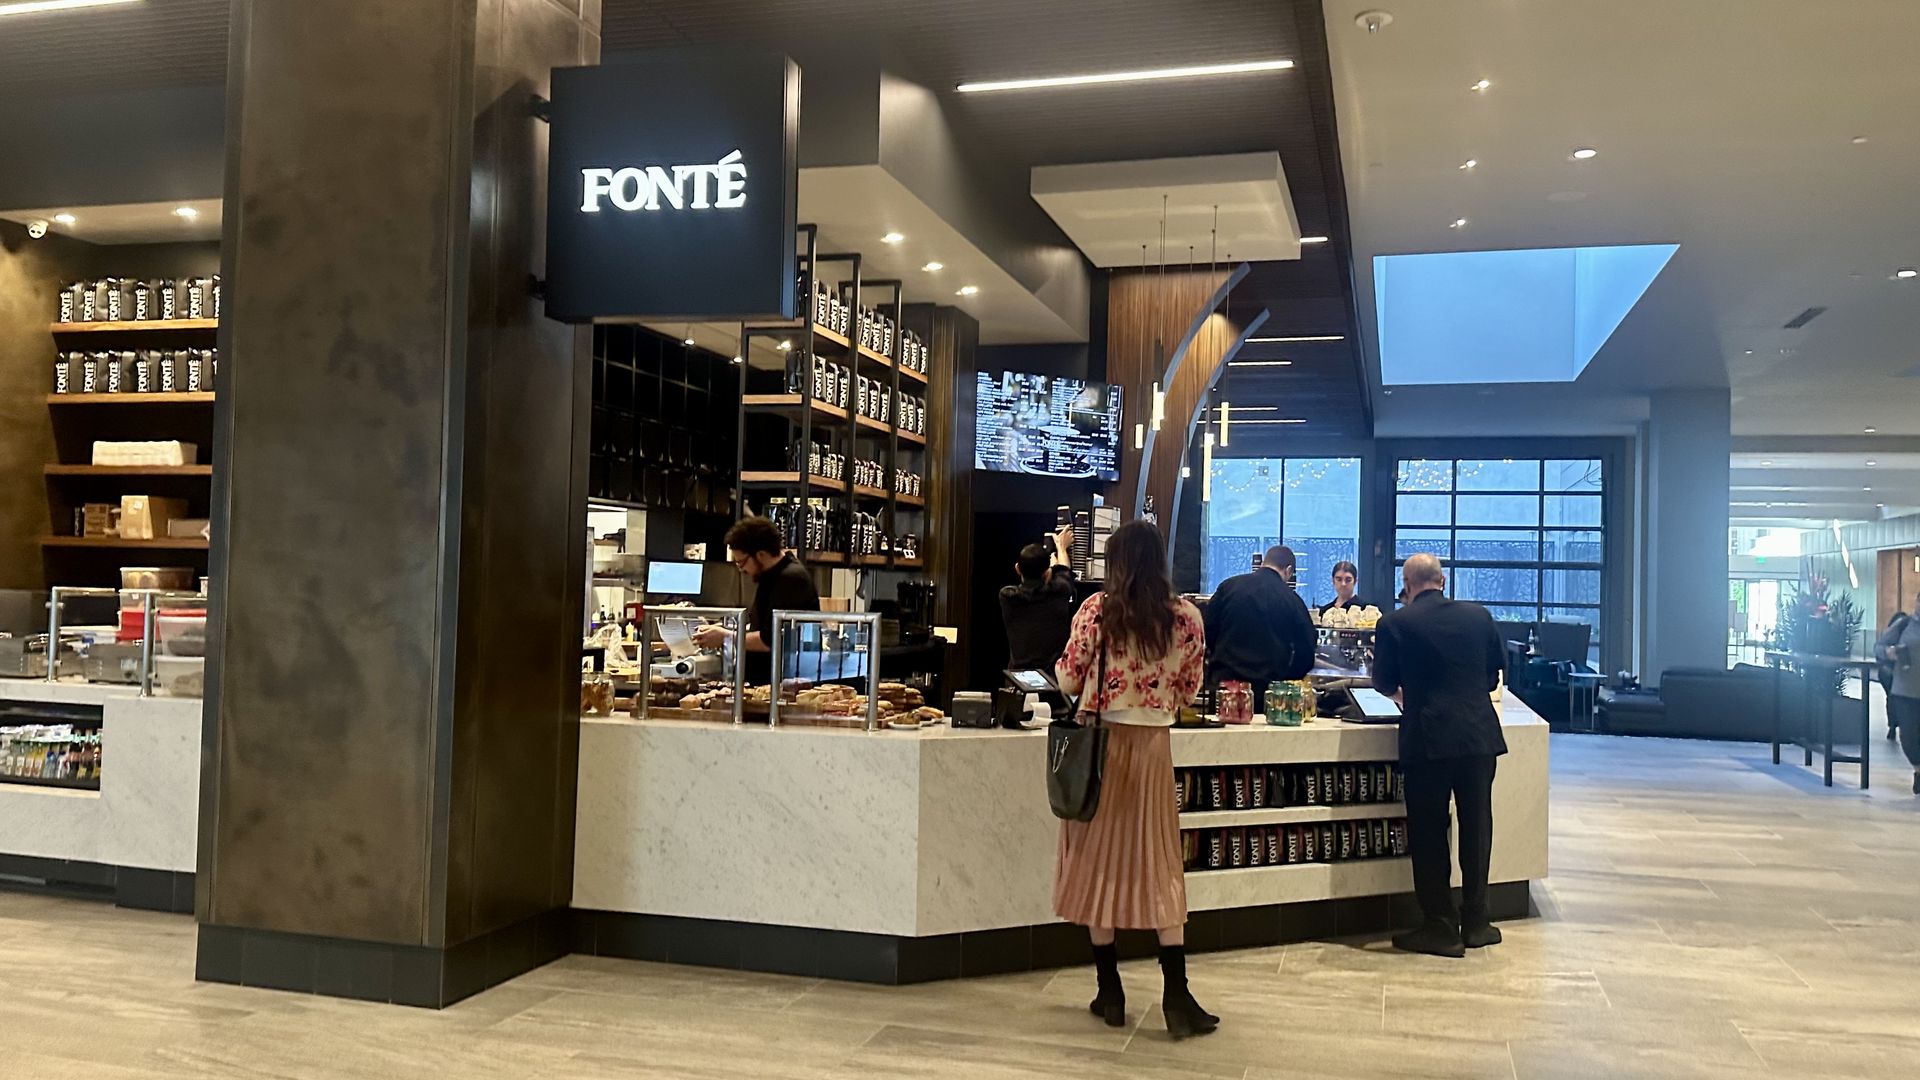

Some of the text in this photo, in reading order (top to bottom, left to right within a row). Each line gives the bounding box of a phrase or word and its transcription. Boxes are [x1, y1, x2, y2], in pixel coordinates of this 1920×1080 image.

[580, 149, 747, 213] FONTÉ
[60, 291, 71, 323] FONTÉ
[83, 290, 93, 321] FONTÉ
[108, 289, 118, 321] FONTÉ
[135, 288, 146, 319] FONTÉ
[162, 288, 172, 319] FONTÉ
[189, 287, 199, 318] FONTÉ
[56, 362, 66, 393] FONTÉ
[83, 361, 94, 392] FONTÉ
[109, 361, 119, 392] FONTÉ
[137, 361, 147, 392] FONTÉ
[161, 360, 172, 391] FONTÉ
[188, 360, 198, 391] FONTÉ
